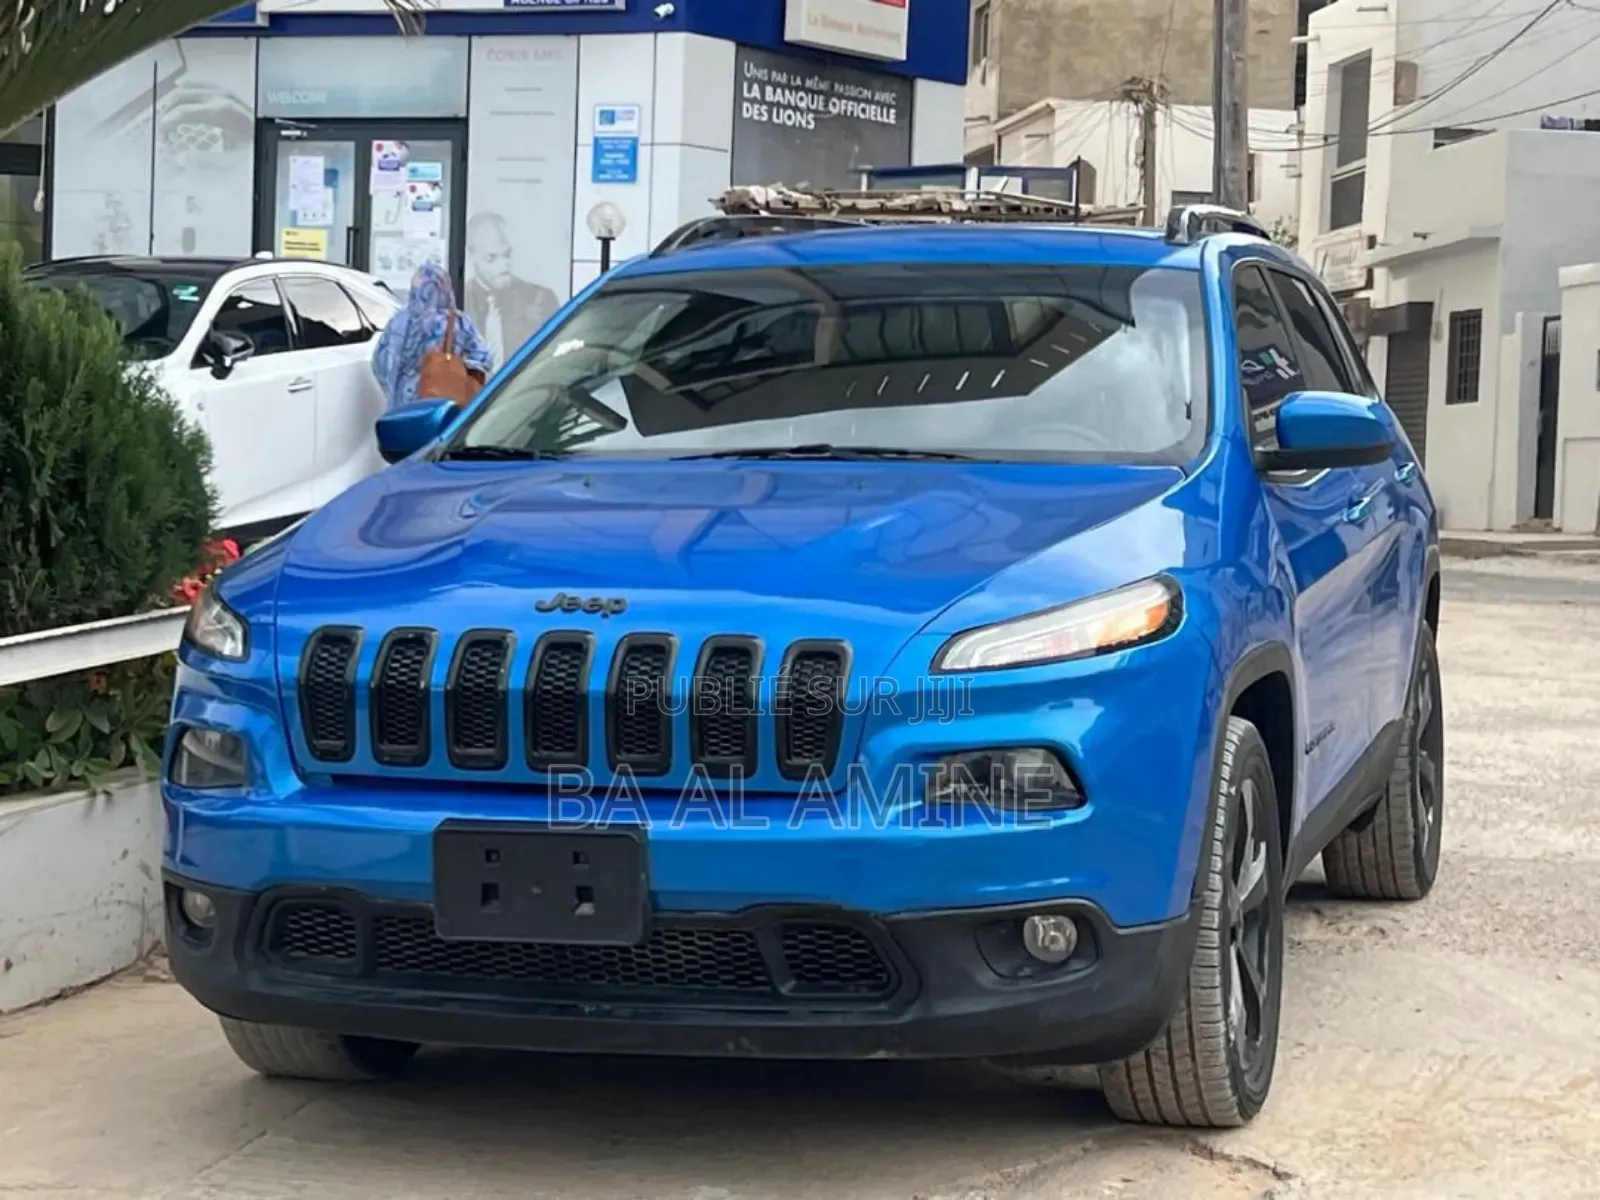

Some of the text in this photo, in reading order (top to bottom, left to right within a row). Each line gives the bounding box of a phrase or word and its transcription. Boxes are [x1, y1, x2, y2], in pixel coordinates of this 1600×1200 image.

[743, 61, 769, 81] UNIS
[771, 71, 789, 85] PAR
[790, 75, 802, 86] LA
[833, 82, 872, 100] PASSION
[874, 90, 897, 105] AVEC
[742, 102, 816, 130] DES LIONS
[743, 81, 897, 125] LA BANQUE OFFICIELLE
[534, 591, 628, 619] Jeep
